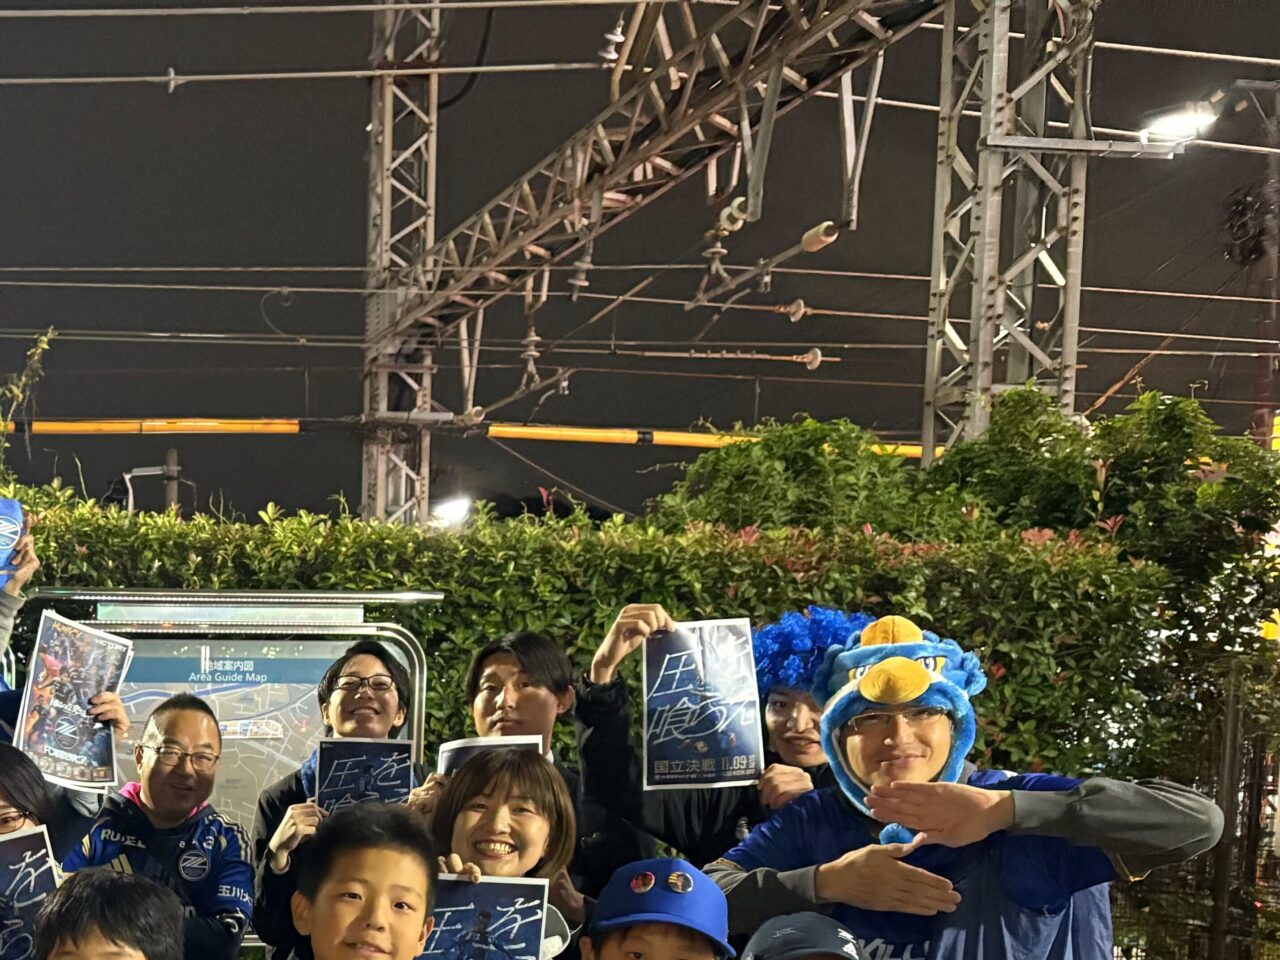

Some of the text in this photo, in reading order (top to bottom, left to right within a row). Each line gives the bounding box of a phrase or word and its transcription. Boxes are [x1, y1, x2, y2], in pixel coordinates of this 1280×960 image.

[189, 672, 267, 684] Area Guide Map
